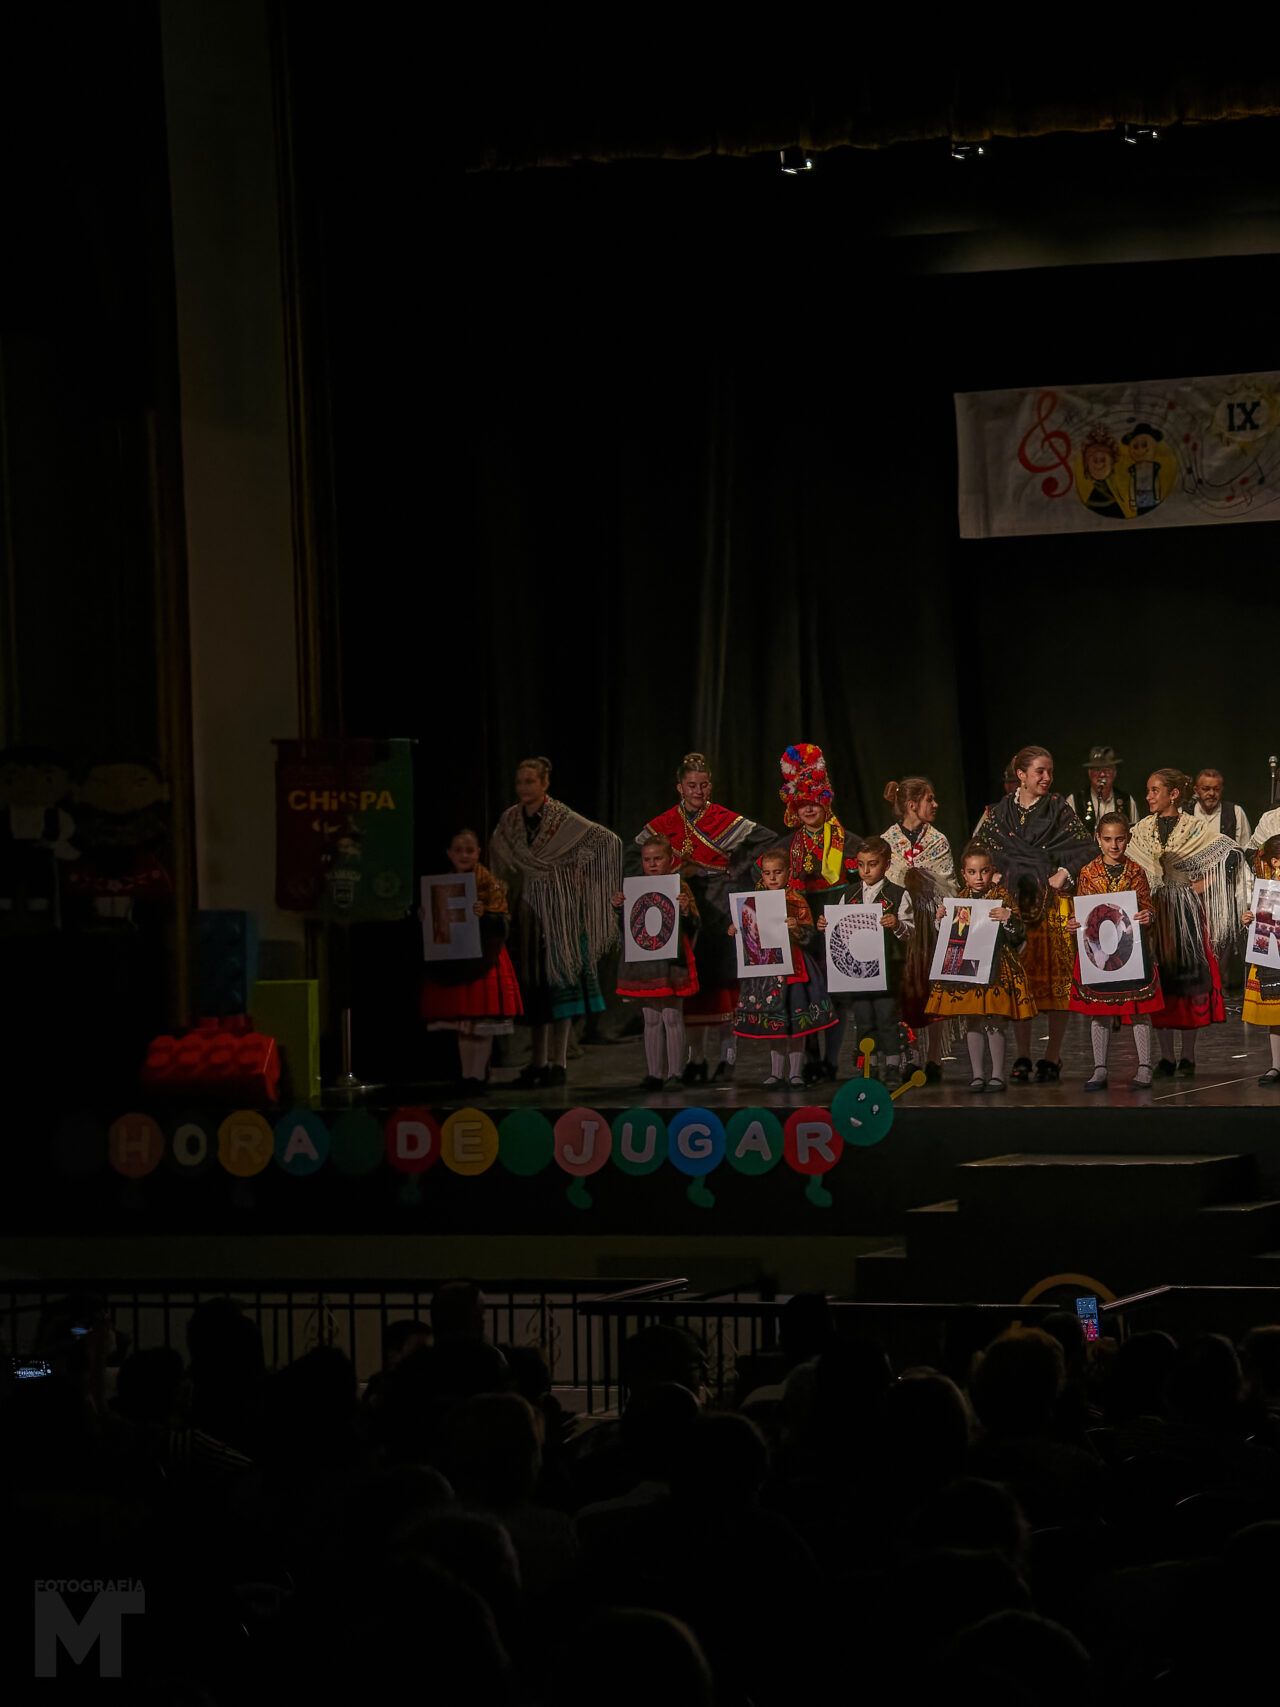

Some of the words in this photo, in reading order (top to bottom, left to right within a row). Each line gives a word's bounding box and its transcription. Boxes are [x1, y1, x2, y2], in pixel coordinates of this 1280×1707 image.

[1226, 401, 1261, 432] IX
[116, 1121, 320, 1166] HORA
[395, 1119, 484, 1163] DE
[562, 1119, 838, 1165] JUGAR
